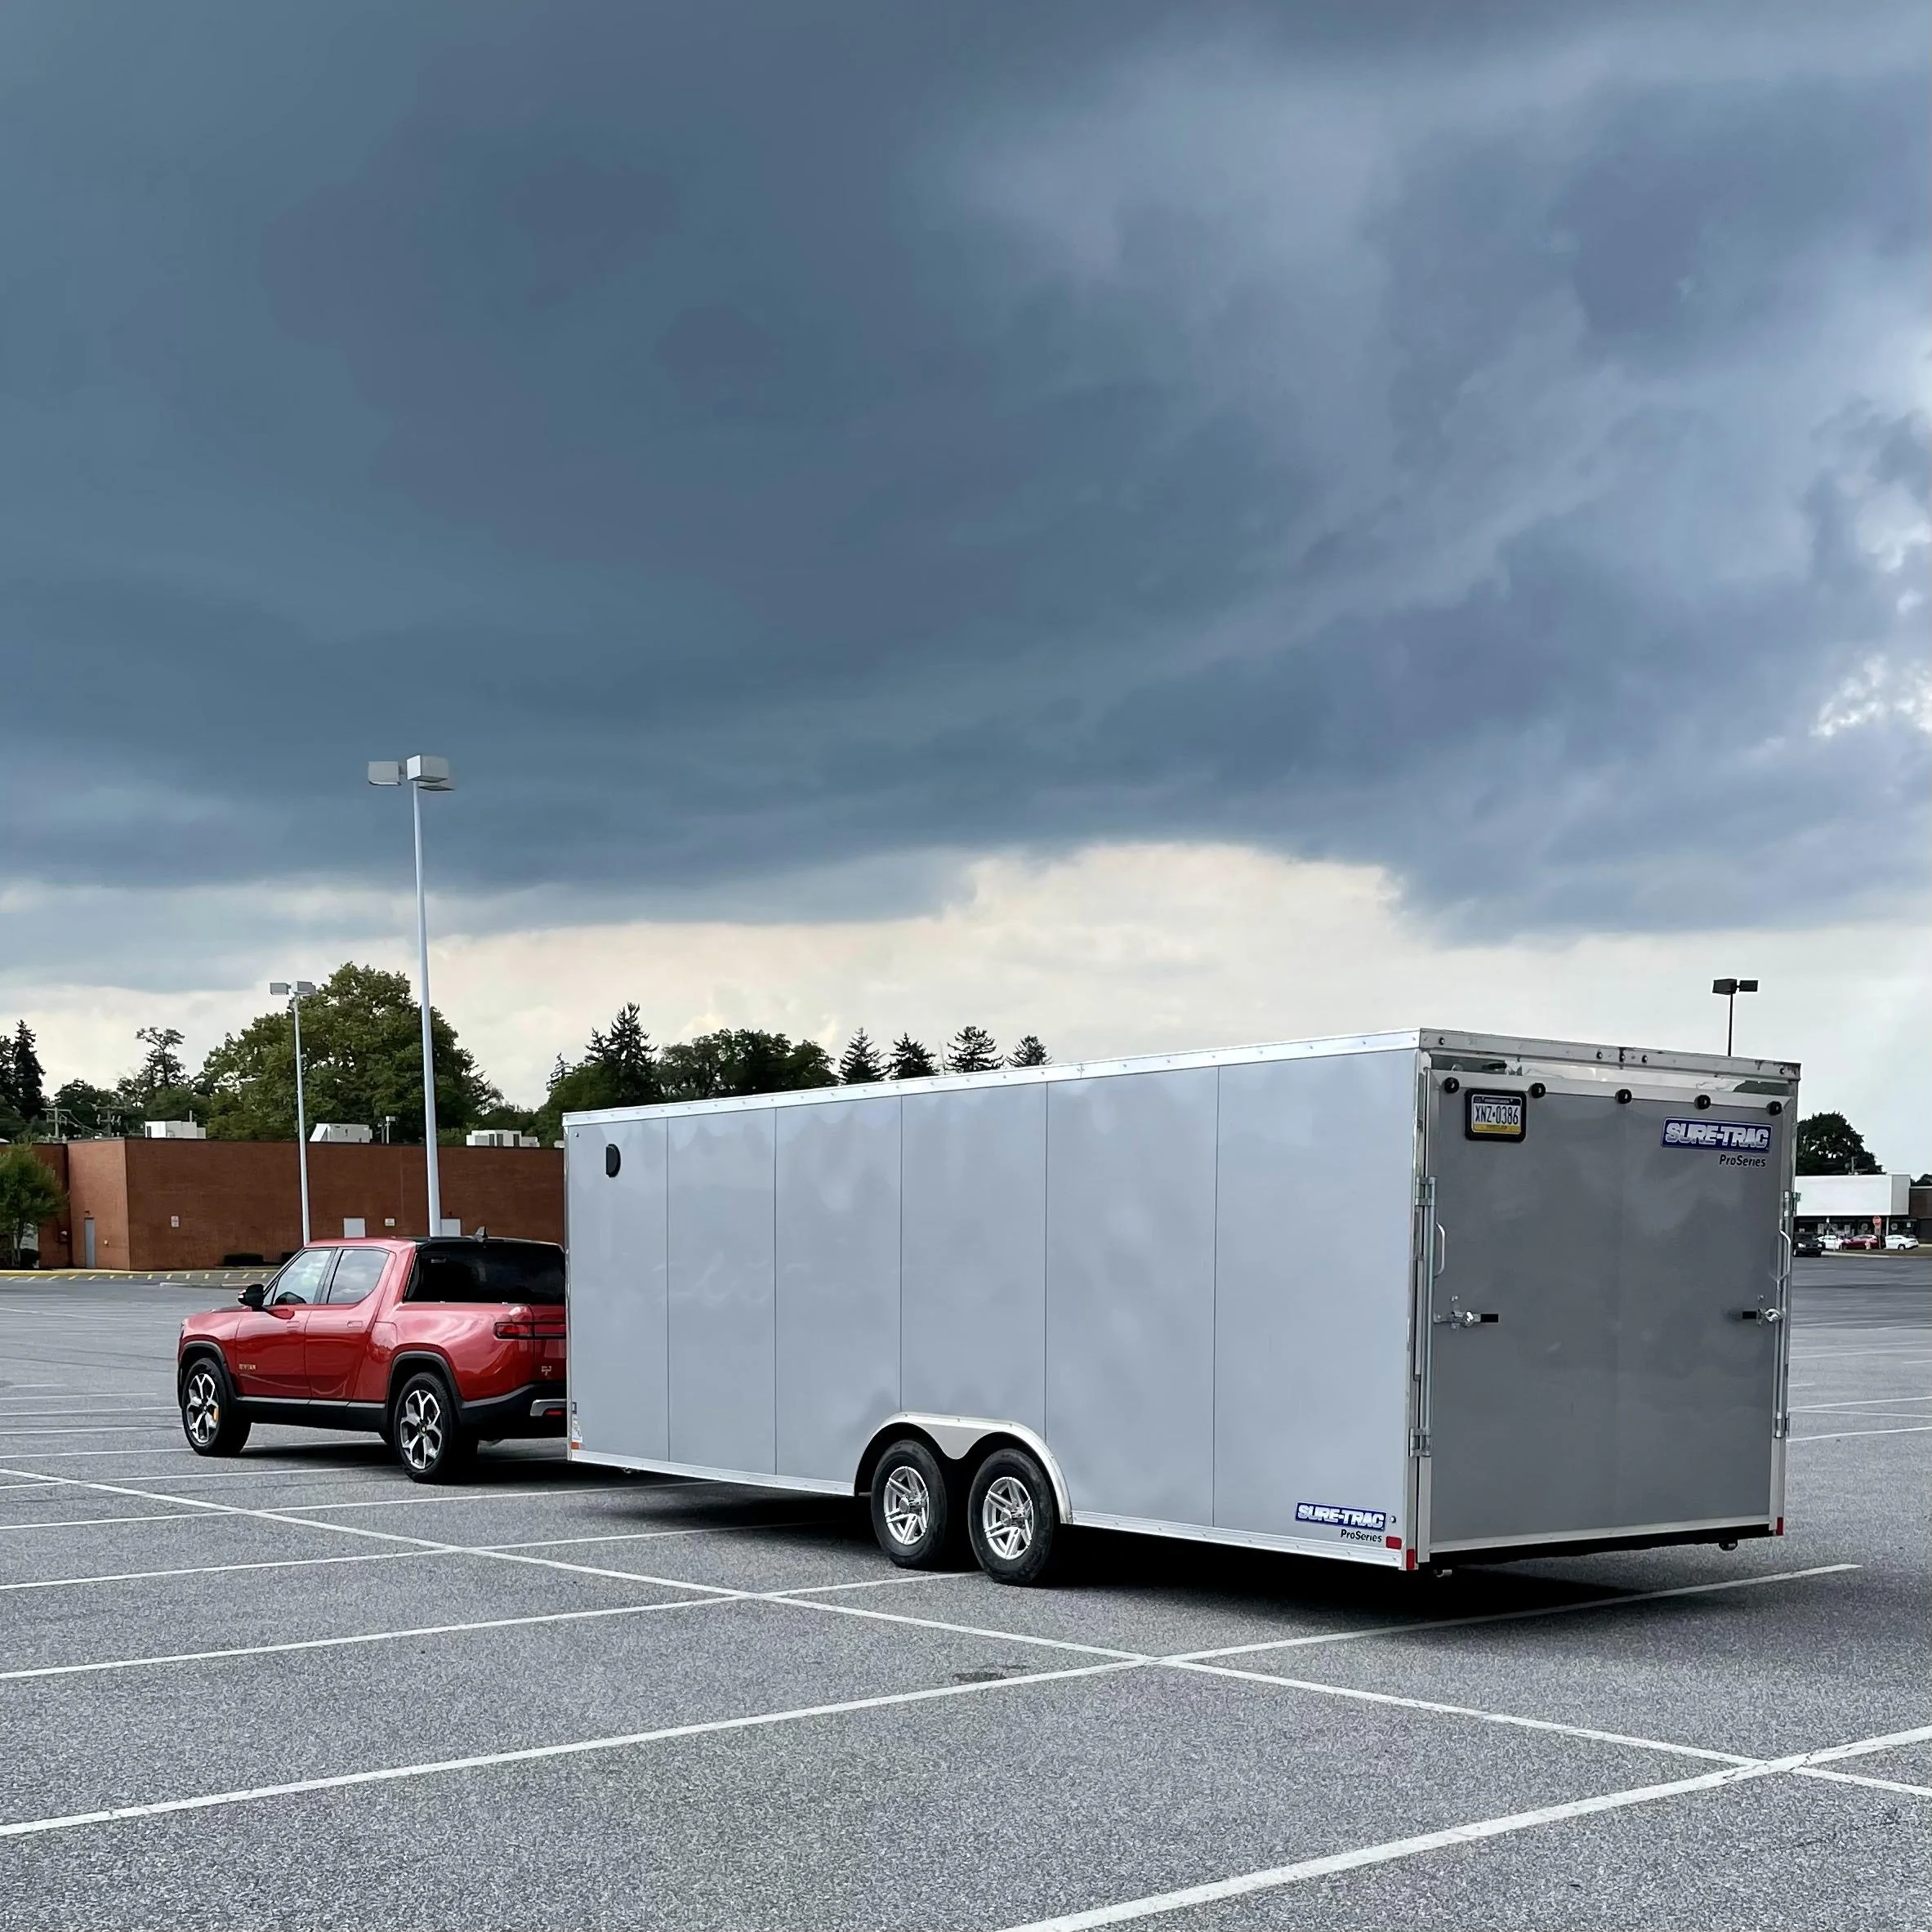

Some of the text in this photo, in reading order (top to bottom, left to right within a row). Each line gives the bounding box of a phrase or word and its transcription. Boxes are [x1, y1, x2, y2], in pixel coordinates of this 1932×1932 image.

[1665, 1122, 1769, 1148] SURE-TRAC
[1719, 1153, 1766, 1167] ProSeries
[1297, 1505, 1385, 1528] SURE-TRAC
[1341, 1528, 1382, 1542] ProSeries
